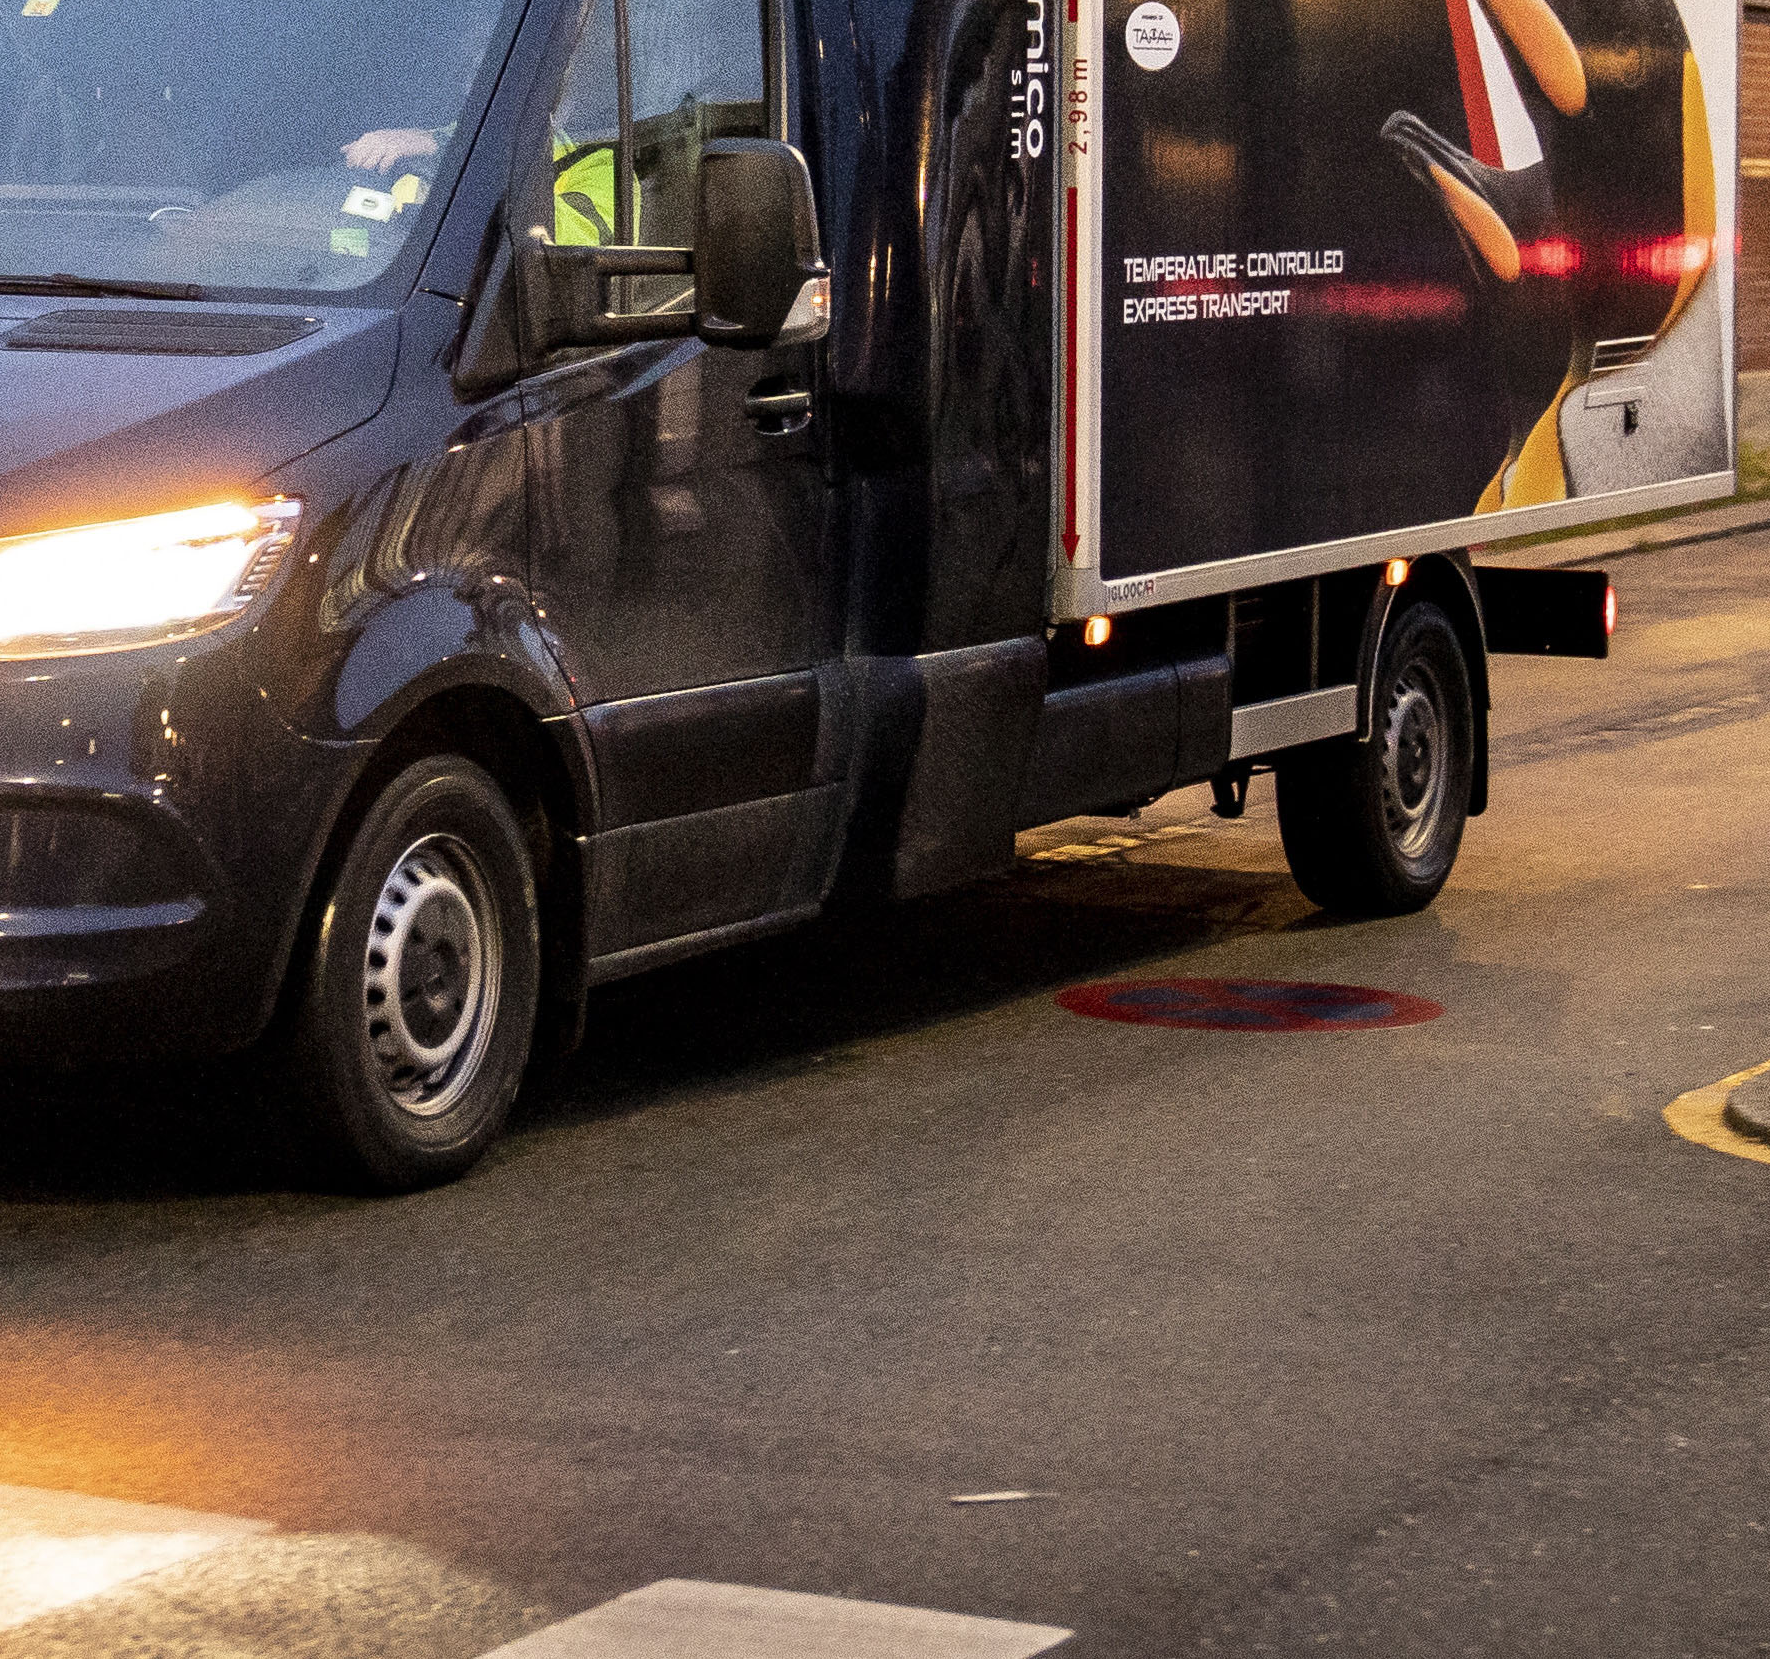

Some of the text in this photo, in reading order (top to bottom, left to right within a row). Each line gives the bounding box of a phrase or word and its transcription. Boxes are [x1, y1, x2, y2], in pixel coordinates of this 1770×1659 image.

[1010, 68, 1026, 160] slim
[1068, 58, 1091, 155] 2,98 m
[1123, 254, 1237, 283] TEMPERATURE
[1246, 250, 1344, 277] CONTROLLED
[1123, 290, 1291, 324] EXPRESS TRANSPORT
